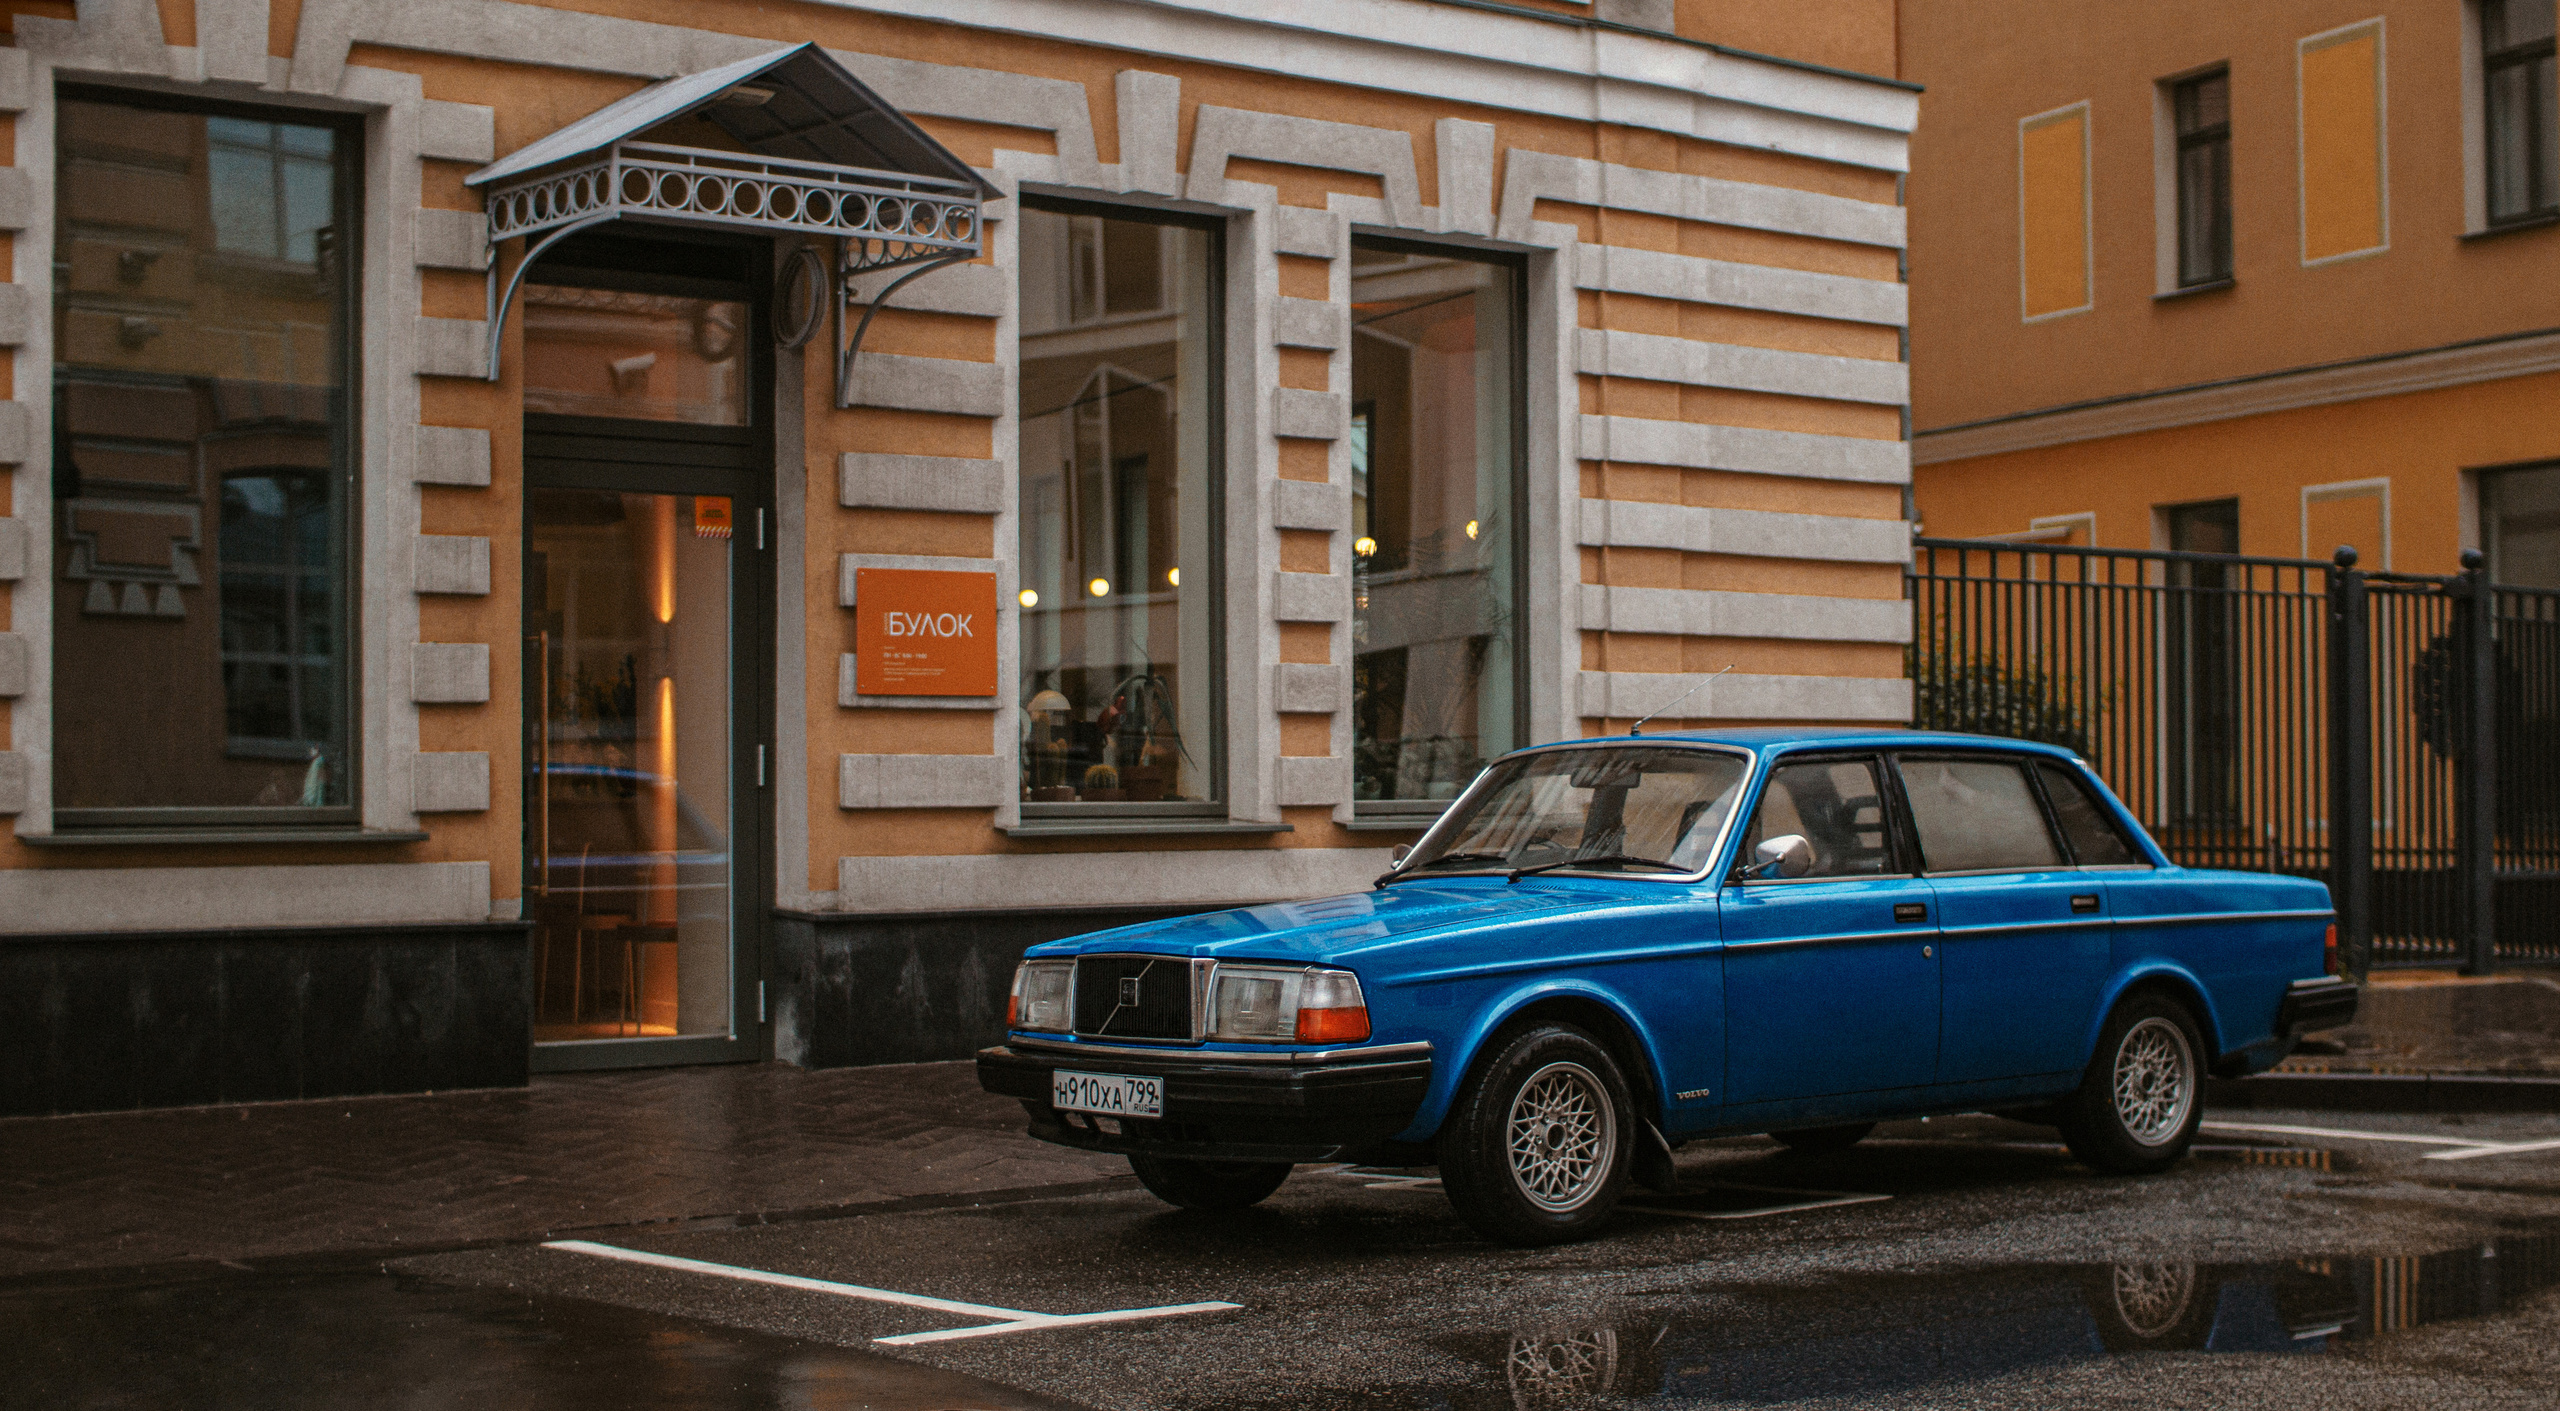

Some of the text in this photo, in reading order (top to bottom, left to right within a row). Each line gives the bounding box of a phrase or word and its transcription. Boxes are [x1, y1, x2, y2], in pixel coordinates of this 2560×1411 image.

[889, 611, 974, 638] БУЛОК
[1126, 1079, 1157, 1104] 799
[1676, 1088, 1710, 1100] VOLVO
[1133, 1103, 1149, 1113] RUS
